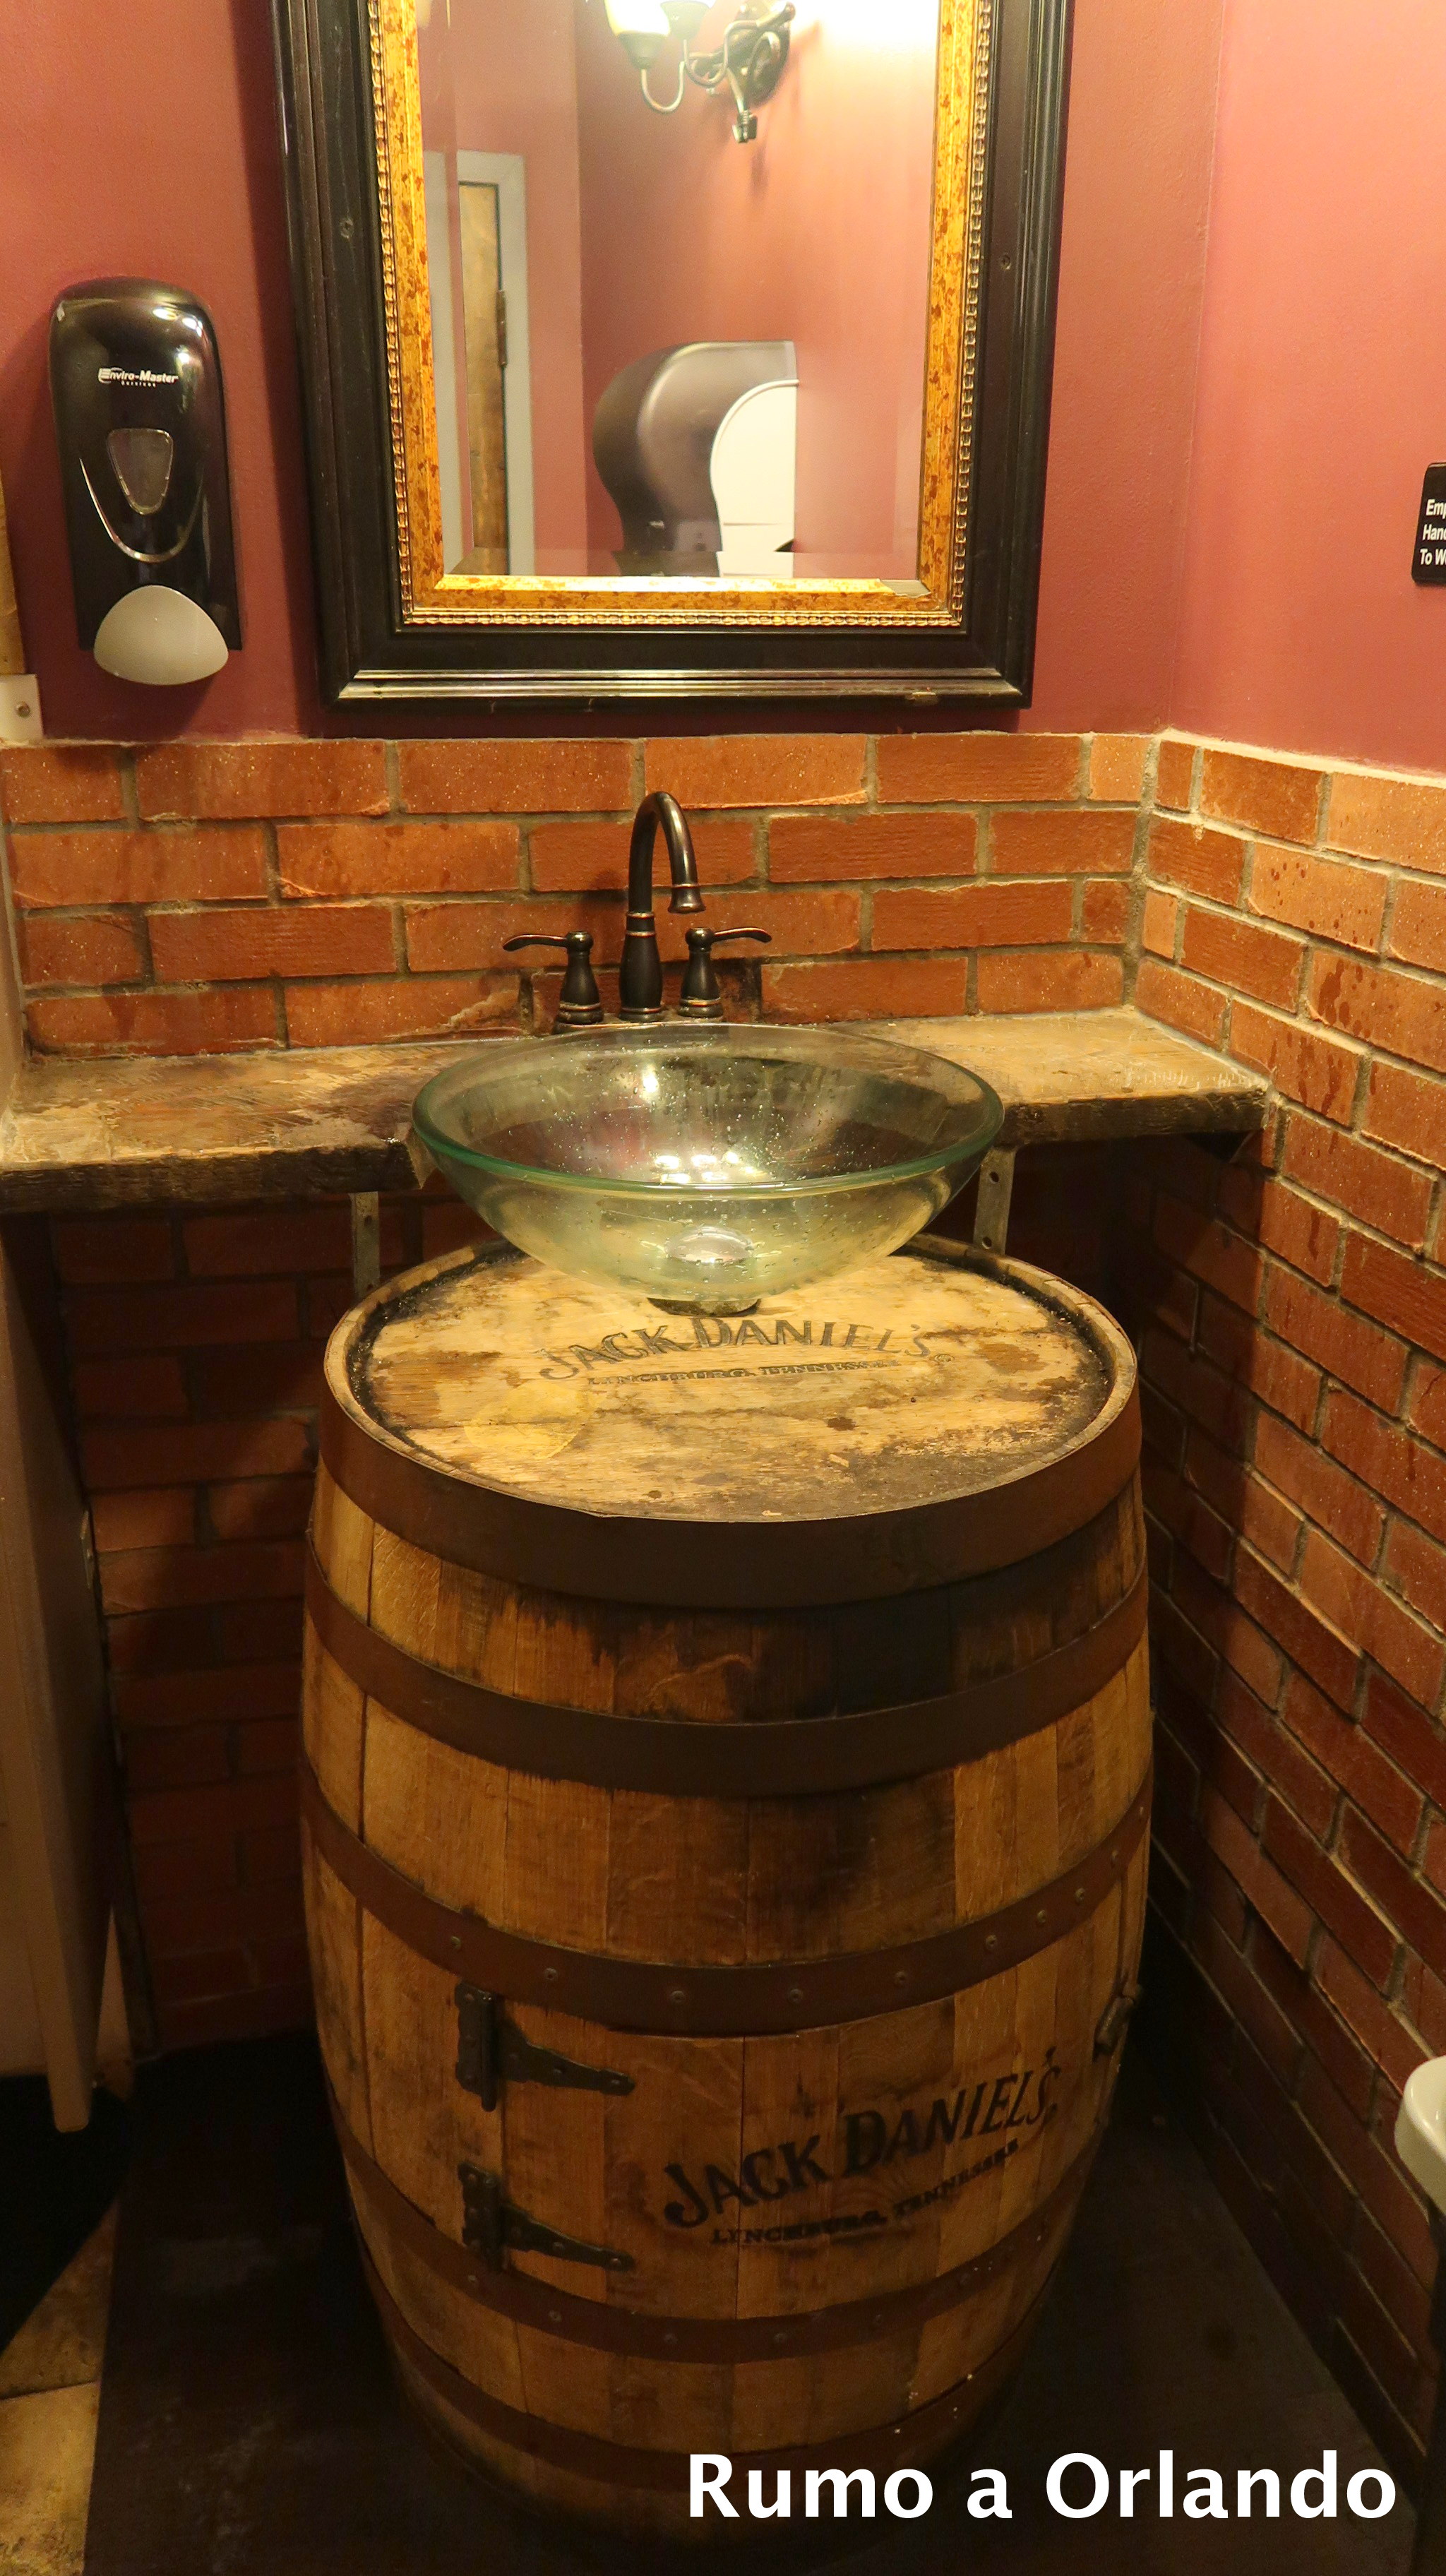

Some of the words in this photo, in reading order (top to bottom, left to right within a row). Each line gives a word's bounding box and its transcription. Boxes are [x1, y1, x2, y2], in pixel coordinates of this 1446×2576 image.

[98, 367, 179, 383] Enviro-Master
[1420, 548, 1433, 566] To
[535, 1324, 687, 1381] JACK
[688, 1317, 931, 1358] DANIEL'S
[663, 2134, 829, 2230] JACK
[840, 2046, 1061, 2178] DANIEL'S
